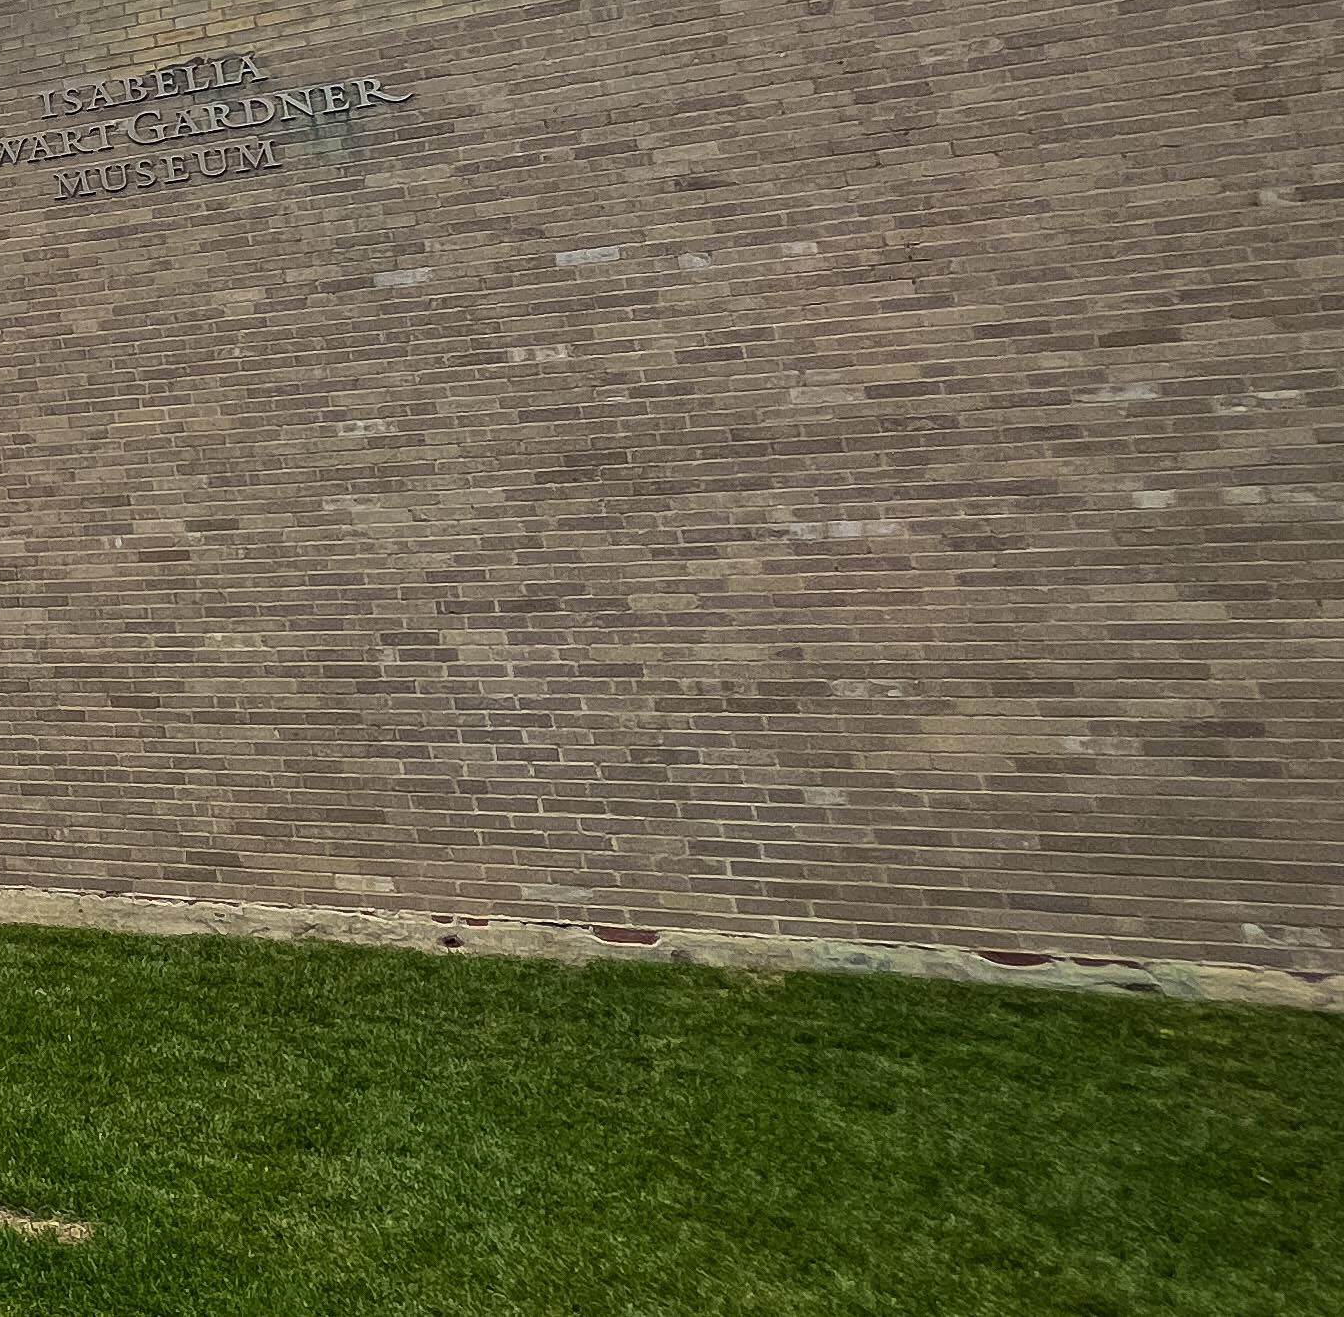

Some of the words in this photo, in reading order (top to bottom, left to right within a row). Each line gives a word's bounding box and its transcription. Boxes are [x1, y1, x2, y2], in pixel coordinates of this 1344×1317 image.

[39, 55, 269, 119] ISABELLA
[127, 78, 413, 145] GARDNER
[53, 139, 283, 200] MUSEUM
